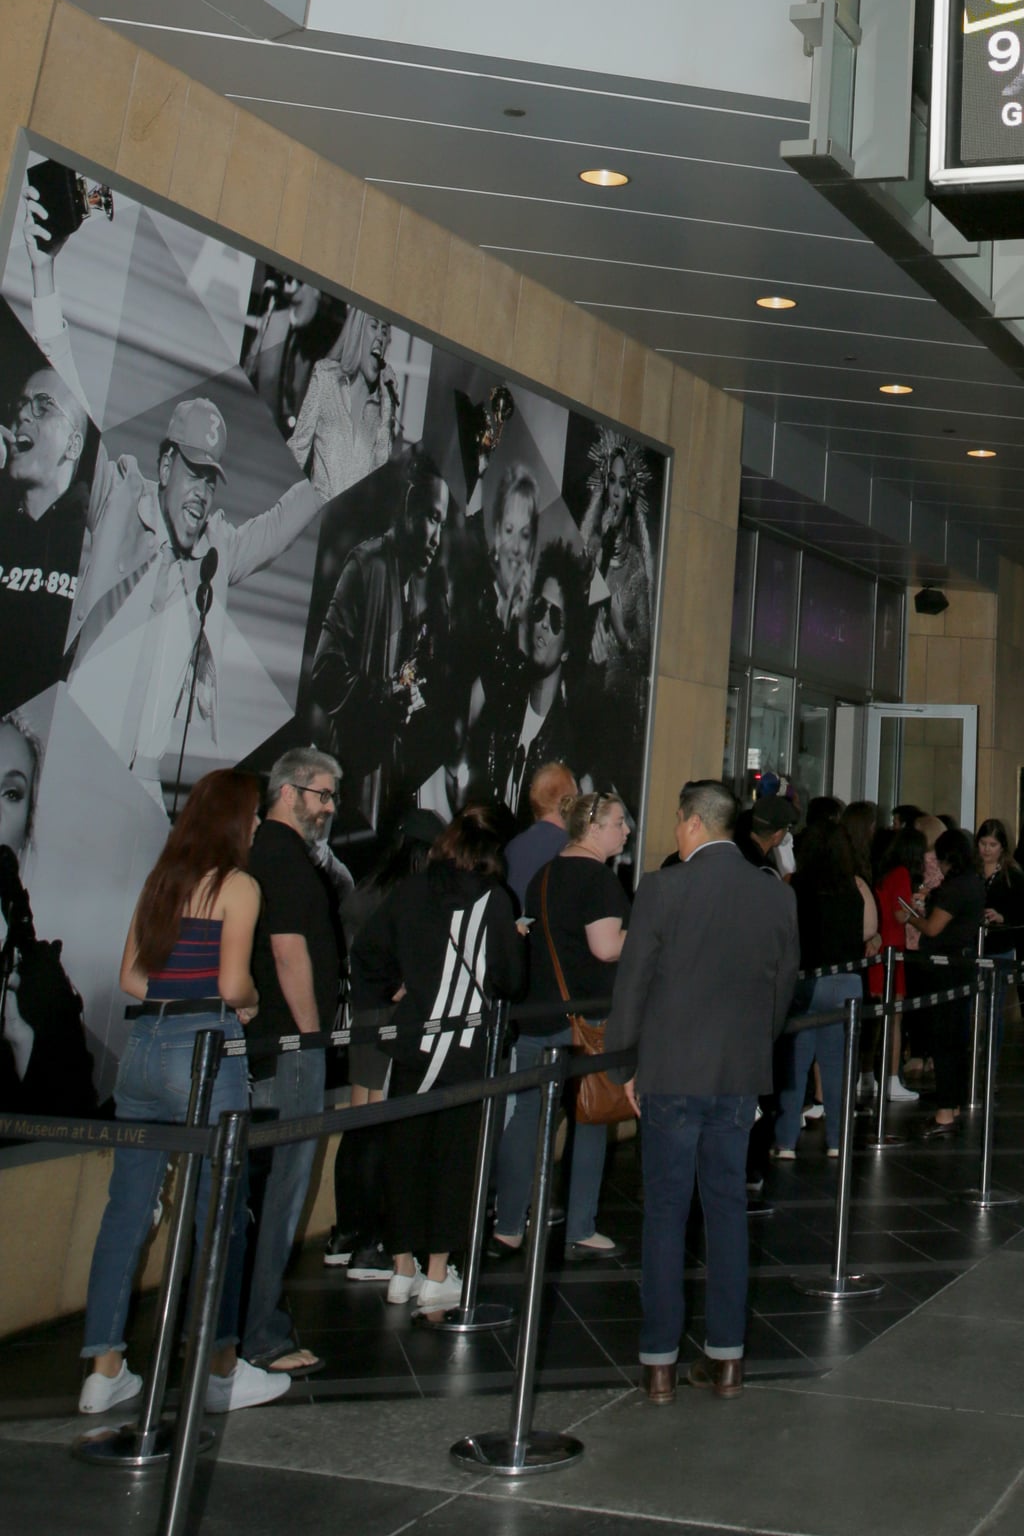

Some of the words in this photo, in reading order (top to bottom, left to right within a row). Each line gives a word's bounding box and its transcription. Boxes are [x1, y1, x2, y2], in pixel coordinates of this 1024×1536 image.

[206, 414, 220, 447] 3
[14, 1120, 68, 1137] Museum
[72, 1125, 84, 1138] at
[88, 1126, 112, 1141] L.A.
[116, 1128, 147, 1144] LIVE
